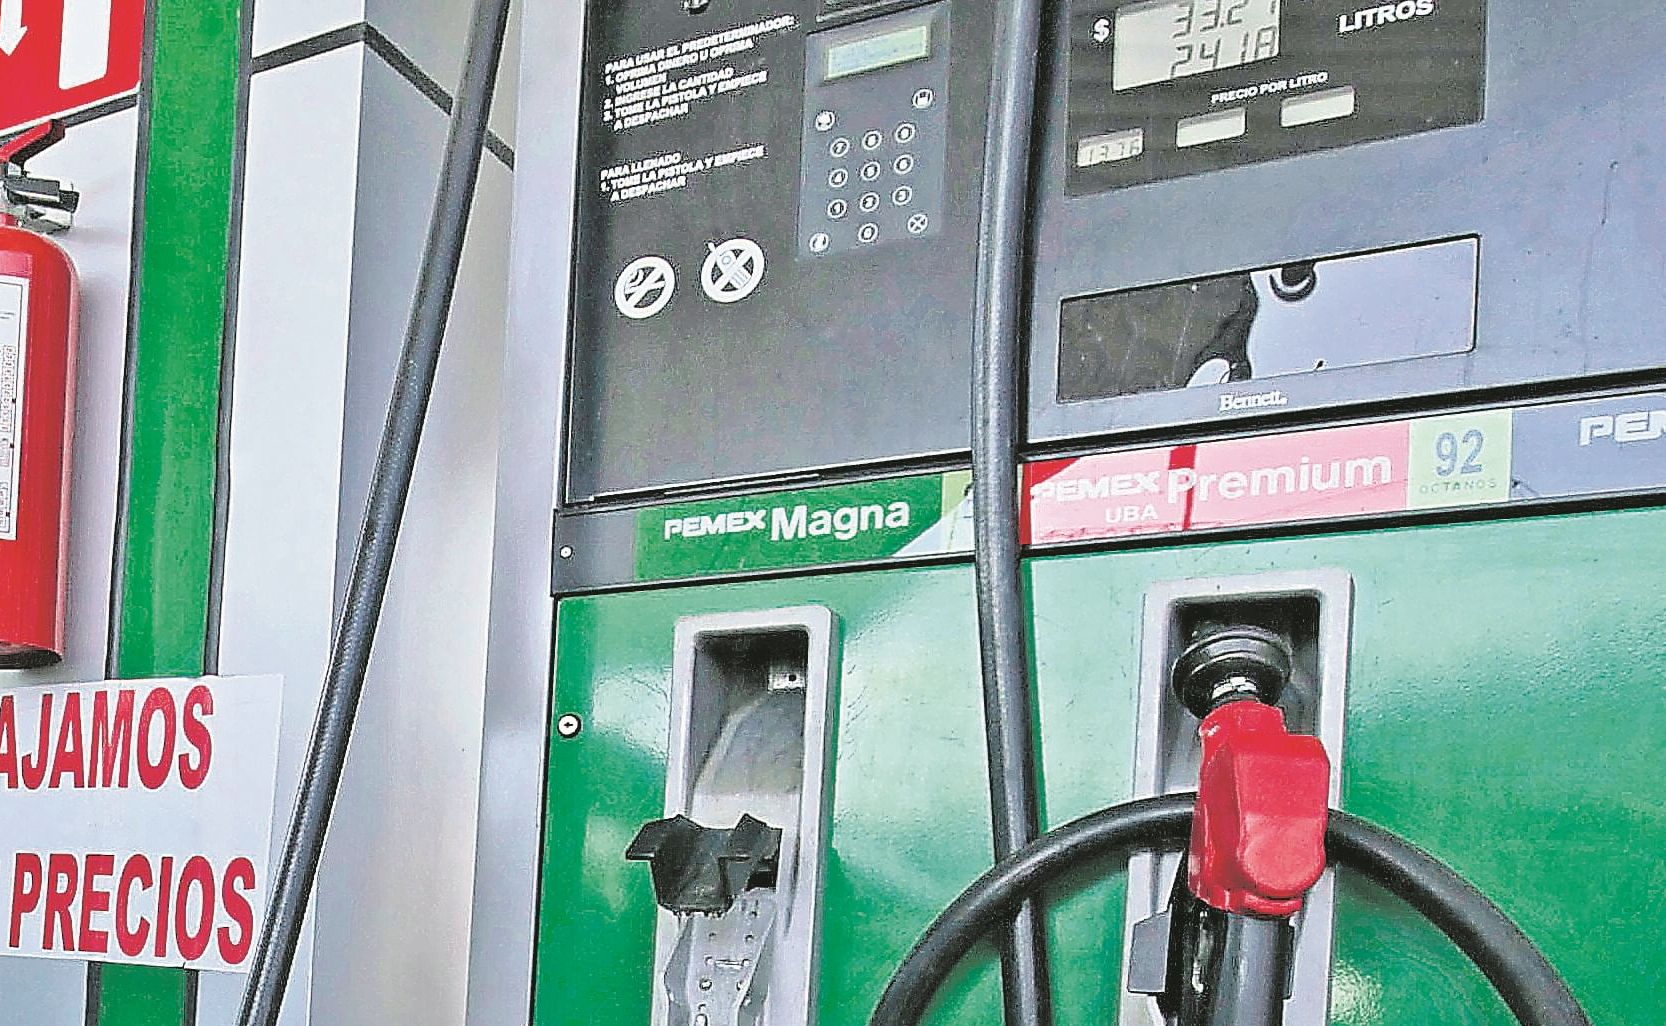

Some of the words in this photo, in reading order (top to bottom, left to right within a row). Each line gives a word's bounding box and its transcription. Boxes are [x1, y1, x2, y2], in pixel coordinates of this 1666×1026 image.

[1091, 18, 1111, 43] $
[1338, 0, 1435, 33] LITROS
[604, 57, 634, 75] PARA
[635, 49, 665, 67] USAR
[665, 44, 680, 59] EL
[615, 62, 657, 84] OPRIMA
[657, 52, 699, 73] DINERO
[699, 49, 709, 62] U
[710, 37, 755, 59] OPRIMA
[615, 71, 668, 95] VOLUMEN
[662, 82, 677, 95] LA
[677, 67, 735, 90] CANTIDAD
[1211, 86, 1259, 104] PRECIO
[1259, 80, 1288, 95] POR
[1289, 72, 1328, 88] LITRO
[613, 118, 623, 132] A
[623, 102, 689, 127] DESPACHAR
[614, 101, 645, 119] TOME
[645, 97, 661, 112] LA
[661, 86, 707, 108] PISTOLA
[706, 84, 717, 97] Y
[600, 164, 631, 181] PARA
[631, 152, 682, 175] LLENADO
[611, 174, 641, 189] TOME
[642, 170, 657, 184] LA
[657, 159, 704, 180] PISTOLA
[703, 156, 714, 170] Y
[609, 191, 621, 202] A
[620, 175, 687, 201] DESPACHAR
[1436, 428, 1484, 477] 92
[1030, 469, 1162, 503] PEMEX
[1167, 456, 1392, 505] Premium
[1418, 479, 1497, 495] OCTANOS
[664, 509, 768, 540] PEMEX
[770, 501, 911, 541] Magna
[1105, 502, 1159, 524] UBA
[8, 852, 257, 966] PRECIOS
